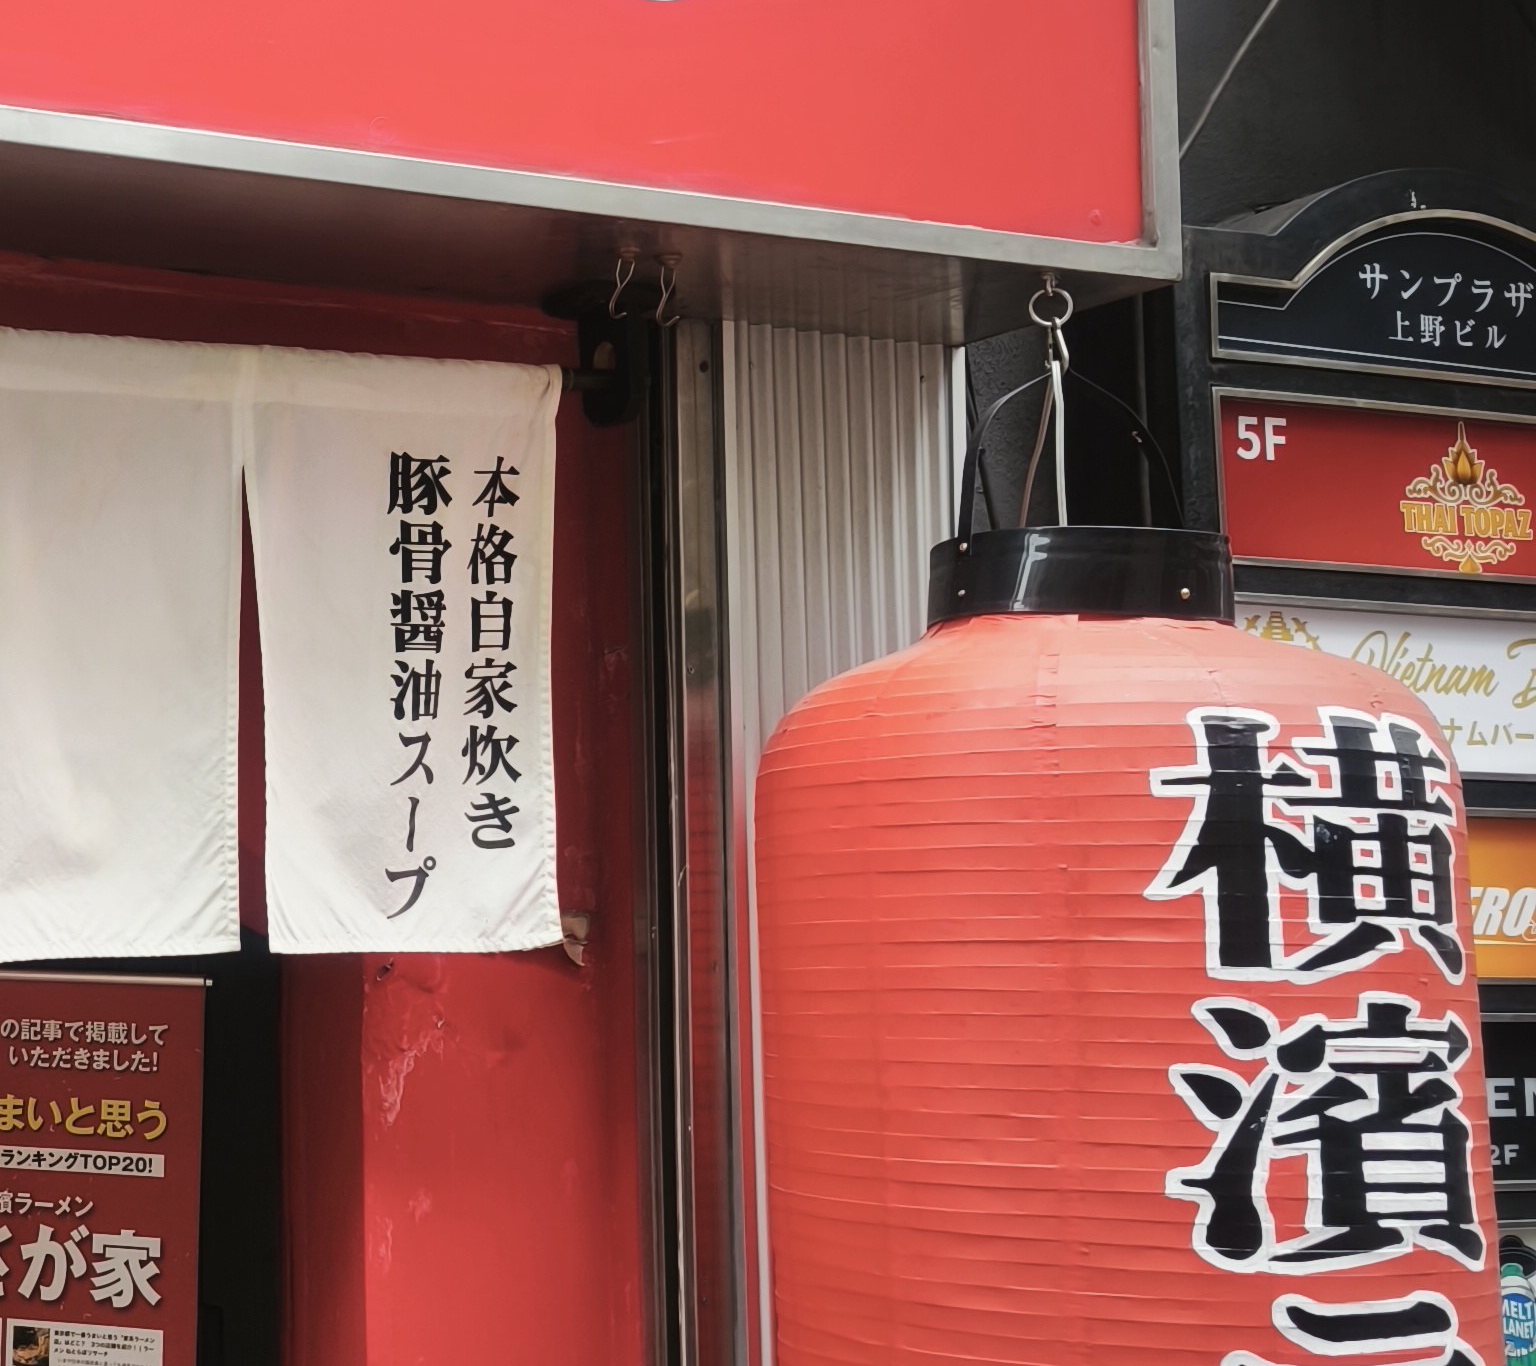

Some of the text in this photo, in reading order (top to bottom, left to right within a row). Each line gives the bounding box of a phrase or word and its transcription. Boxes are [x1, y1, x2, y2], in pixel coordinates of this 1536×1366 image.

[1358, 262, 1535, 318] サンプラザ
[1388, 310, 1507, 349] 上野ビル
[1236, 416, 1287, 461] 5F
[1400, 500, 1533, 541] THAI TOPAZ
[461, 455, 522, 850] 本格自家炊き
[1350, 630, 1500, 698] Vietnam
[385, 451, 453, 920] 豚骨醤油スープ
[0, 1018, 170, 1047] の記事で掲載して
[8, 1044, 160, 1073] いただきました!
[0, 1148, 154, 1174] ランキングTOP20!
[1490, 1144, 1520, 1166] 2F
